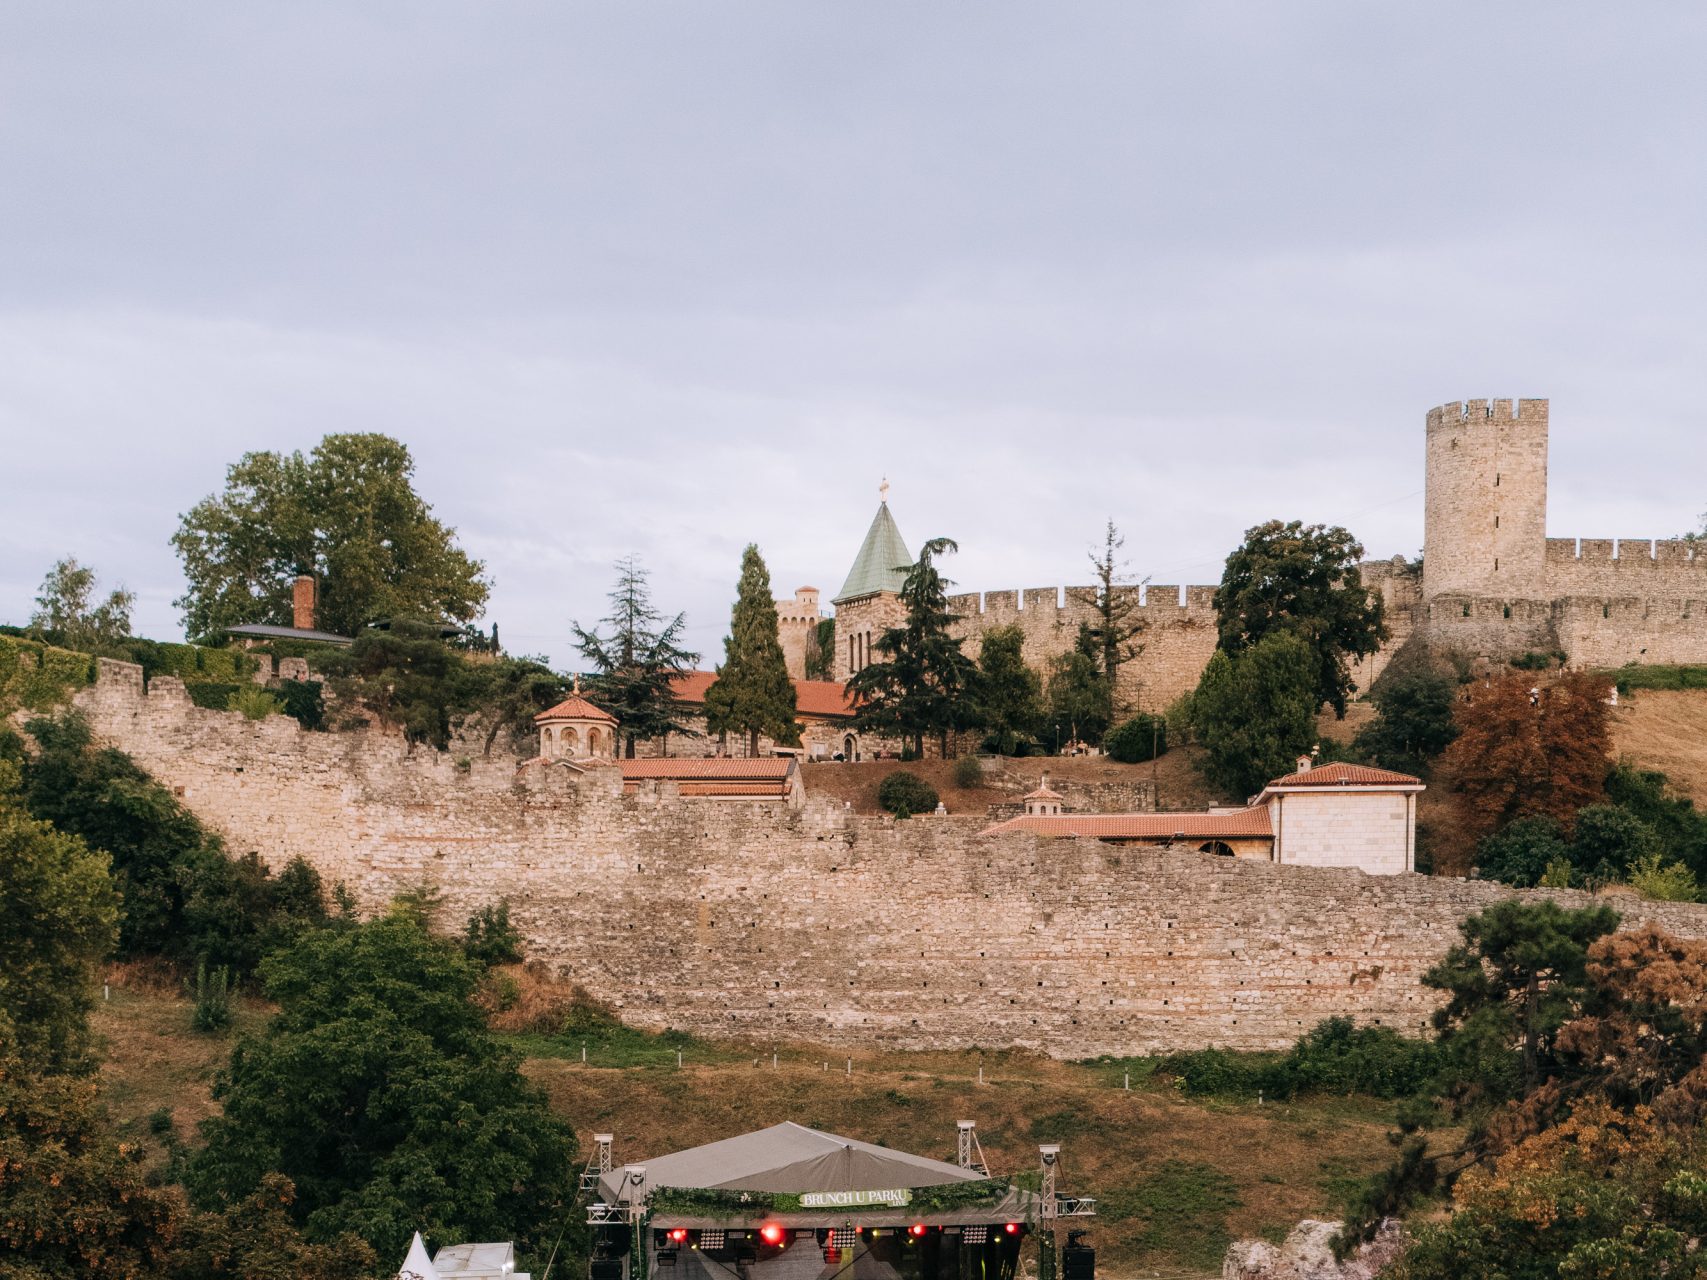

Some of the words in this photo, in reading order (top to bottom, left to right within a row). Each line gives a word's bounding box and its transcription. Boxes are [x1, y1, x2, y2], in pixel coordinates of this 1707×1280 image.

[804, 1192, 852, 1206] BRUNCH
[856, 1191, 865, 1203] U
[869, 1189, 907, 1202] PARKU
